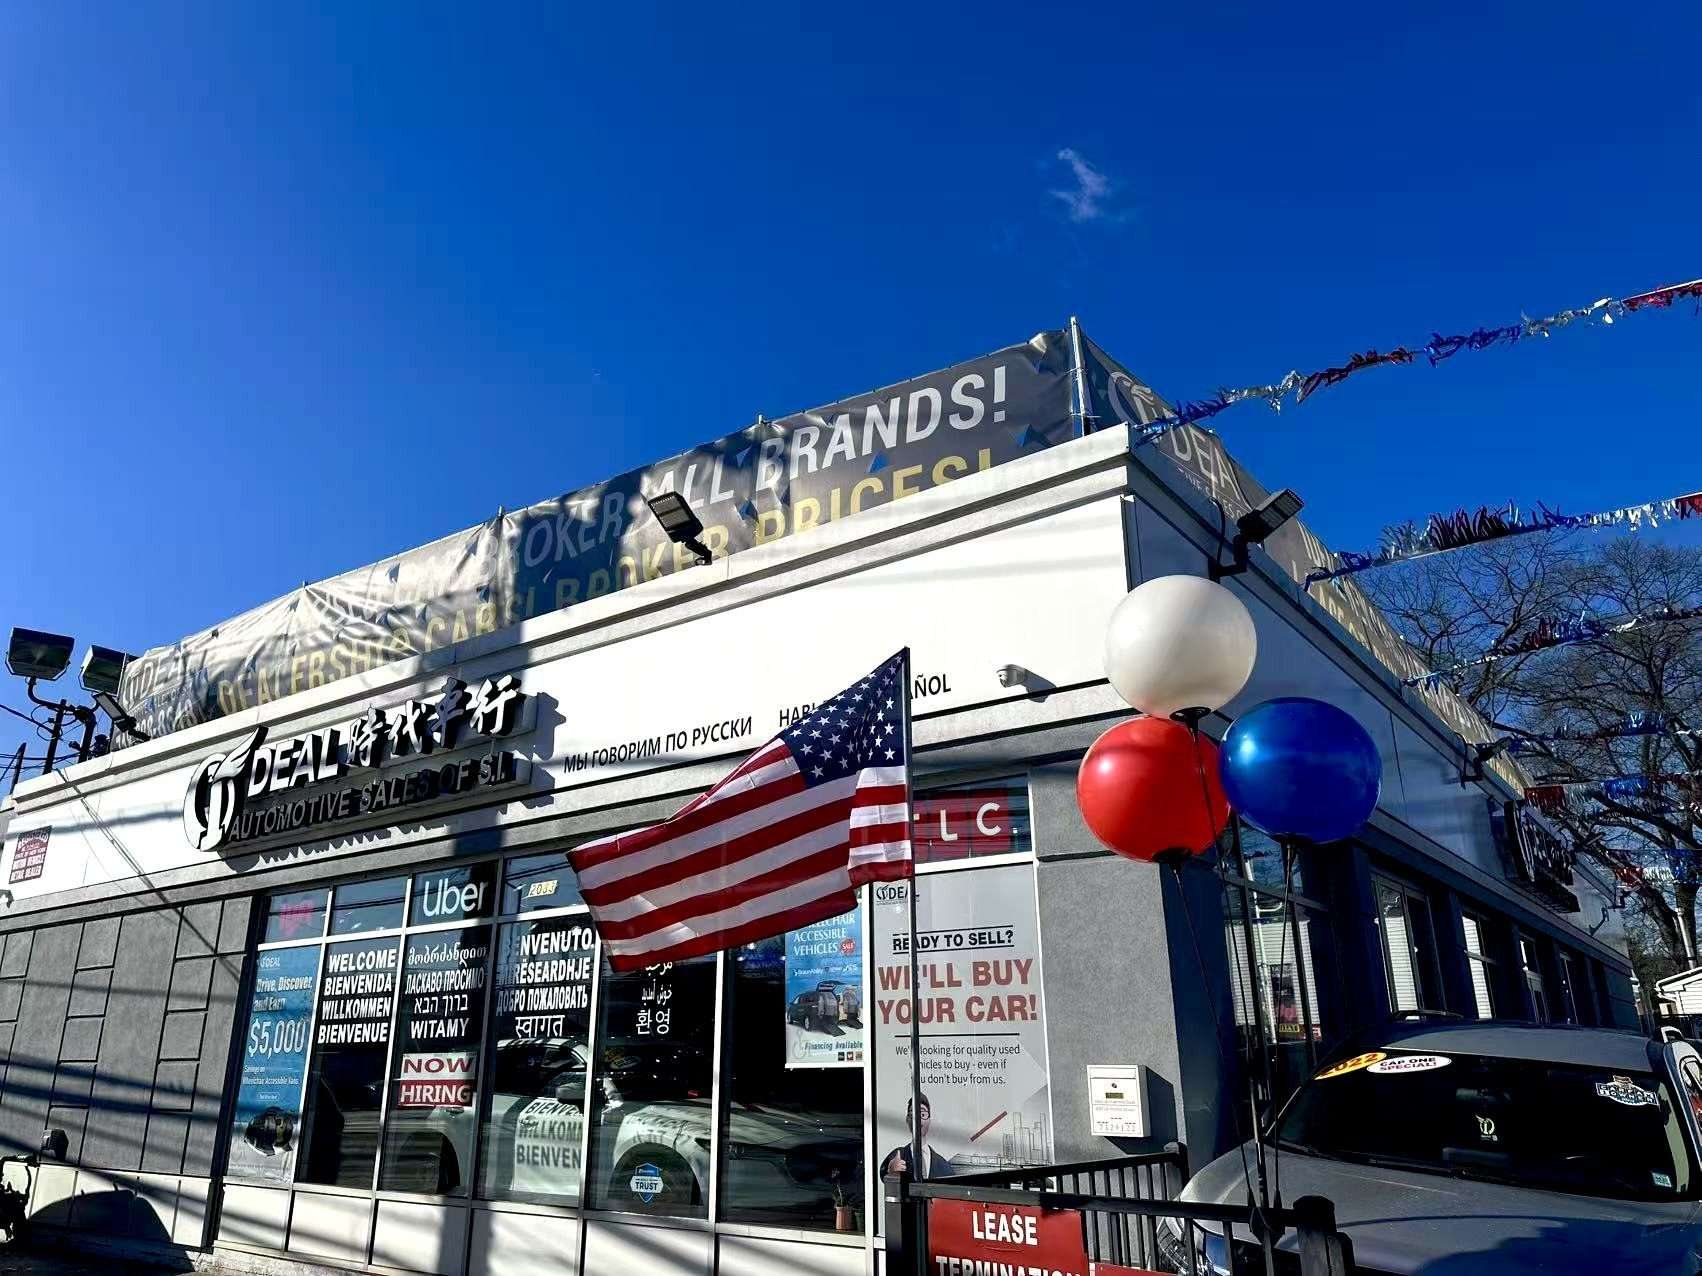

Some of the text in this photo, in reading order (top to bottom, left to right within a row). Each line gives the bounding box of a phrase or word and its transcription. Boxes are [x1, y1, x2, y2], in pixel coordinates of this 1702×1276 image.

[755, 366, 1006, 492] BRANDS!
[563, 716, 752, 774] МЫ ГОВОРИМ ПО РУССКИ
[228, 789, 352, 842] AUTOMOTIVE
[361, 770, 430, 812] SALES
[440, 761, 471, 796] OF
[422, 877, 489, 917] Uber
[793, 927, 848, 942] ACCESSIBLE
[944, 933, 964, 947] TO
[968, 930, 1014, 946] SELL?
[793, 942, 838, 956] VEHICLES
[328, 949, 397, 973] WELCOME
[324, 972, 393, 996] BIENVENIDA
[405, 967, 485, 995] ЛАСКАВО ПРОСИМО
[972, 959, 1033, 987] BUY
[321, 997, 392, 1020] WILLKOMMEN
[414, 993, 468, 1017] ברוך הבא
[496, 984, 589, 1016] ДОБРО ПОЖАЛОВАТЬ
[877, 994, 1038, 1025] YOUR CAR!
[317, 1022, 389, 1044] BIENVENUE
[411, 1017, 470, 1040] WITAMY
[514, 1014, 566, 1038] स्वागत
[635, 1008, 671, 1035] 환영
[249, 1018, 305, 1059] $5,000
[804, 1040, 863, 1051] Financing Available
[919, 1045, 951, 1057] looking
[952, 1044, 964, 1055] for
[966, 1044, 996, 1057] quality
[998, 1044, 1020, 1055] used
[403, 1057, 475, 1073] NOW
[910, 1059, 943, 1070] hicles
[944, 1060, 953, 1069] to
[954, 1059, 970, 1071] buy
[977, 1061, 999, 1069] even
[1000, 1058, 1007, 1069] if
[1379, 1059, 1406, 1067] CAP
[1380, 1061, 1437, 1071] SPECIAL!
[927, 1073, 950, 1084] don't
[952, 1073, 968, 1087] buy
[970, 1073, 991, 1084] from
[400, 1084, 473, 1103] HIRING
[635, 1181, 658, 1191] TRUST
[971, 1210, 1038, 1247] LEASE
[935, 1256, 1081, 1276] TERMIN
